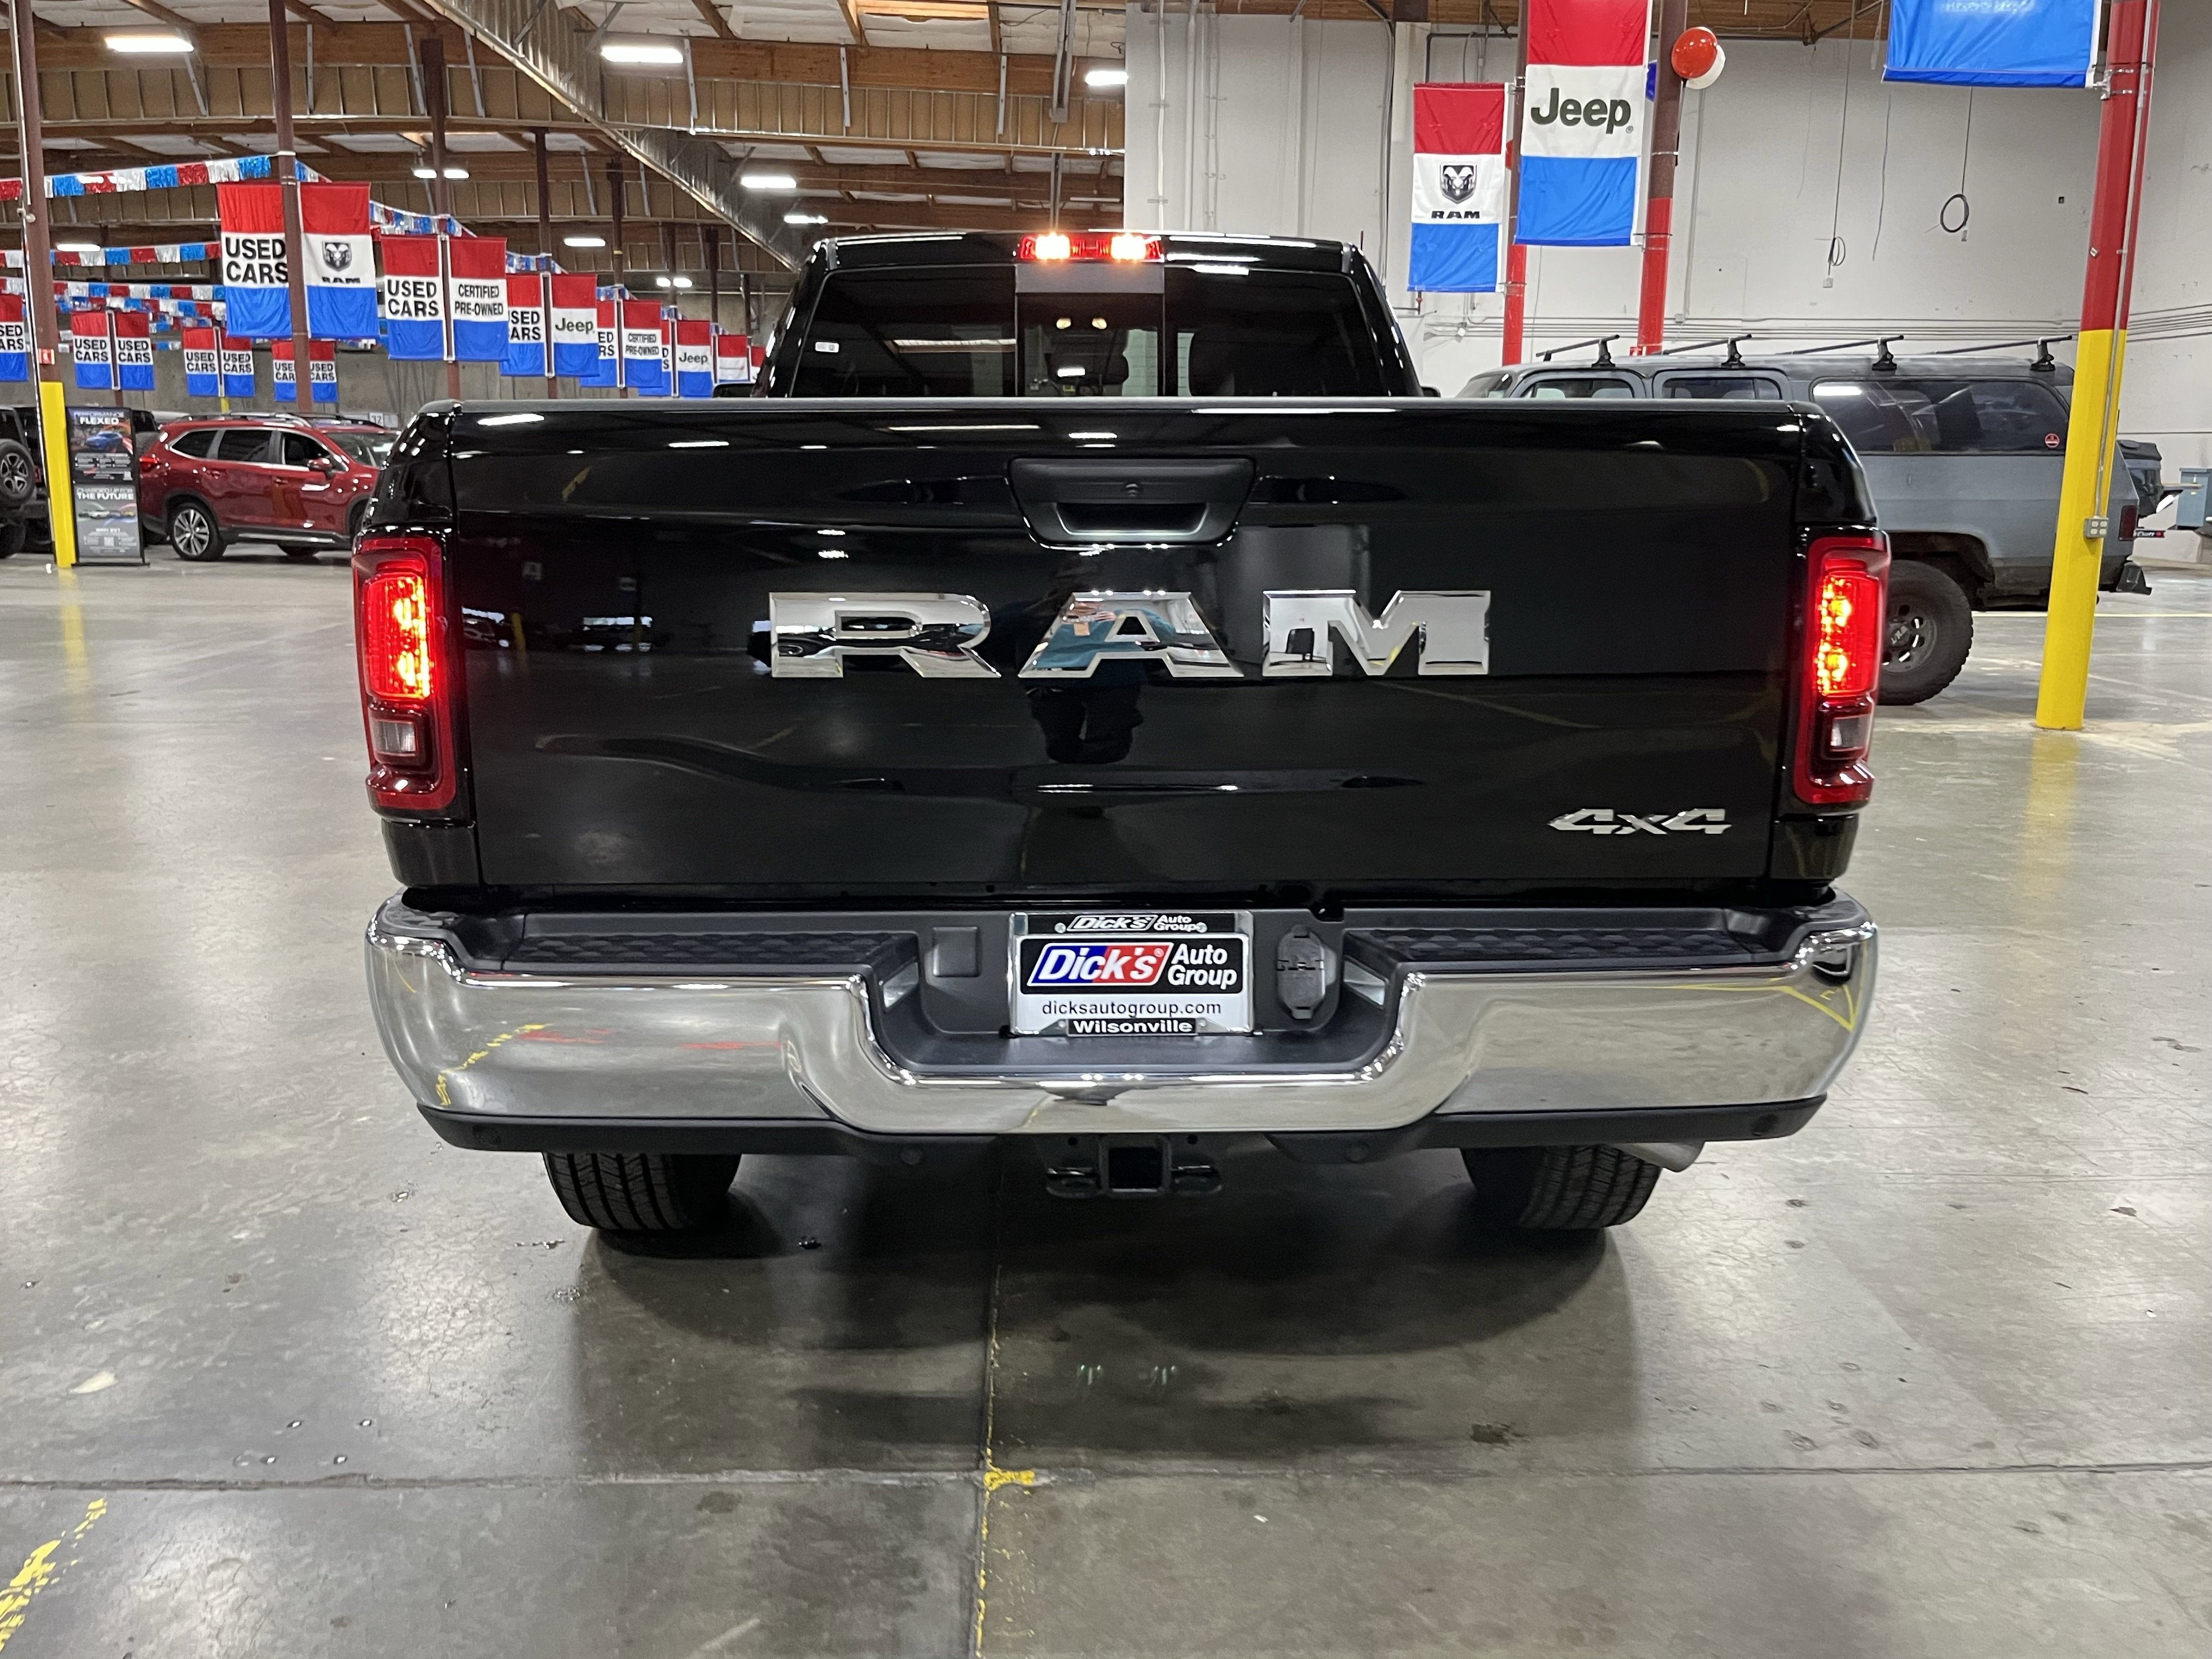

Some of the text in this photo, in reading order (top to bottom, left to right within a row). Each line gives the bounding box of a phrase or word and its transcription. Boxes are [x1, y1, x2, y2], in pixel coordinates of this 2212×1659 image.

[1531, 88, 1631, 134] Jeep
[1431, 210, 1480, 219] RAM
[225, 236, 286, 260] USED
[227, 261, 288, 284] CARS
[387, 279, 437, 298] USED
[458, 284, 499, 298] CERTIFIED
[388, 298, 439, 317] CARS
[455, 301, 504, 316] PRE-OWNED
[509, 311, 540, 325] SED
[0, 325, 22, 336] SED
[555, 318, 594, 334] Jeep
[510, 326, 541, 340] ARS
[598, 331, 613, 343] ED
[628, 333, 656, 343] CERTIFIED
[0, 338, 24, 350] ARS
[75, 339, 107, 350] USED
[118, 340, 149, 351] USED
[76, 351, 109, 362] CARS
[599, 345, 614, 356] RS
[625, 345, 659, 356] PRE-OWNED
[119, 352, 151, 363] CARS
[187, 352, 215, 362] USED
[223, 352, 251, 363] USED
[679, 352, 708, 365] Jeep
[187, 363, 216, 372] CARS
[223, 363, 252, 373] CARS
[275, 363, 293, 371] USE
[276, 372, 295, 381] CAR
[80, 416, 119, 425] FLEXED
[769, 590, 1491, 679] RAM
[1547, 809, 1732, 834] 4x4
[1073, 916, 1149, 929] Dick's
[1156, 915, 1192, 923] Auto
[1154, 922, 1197, 932] Group
[1171, 944, 1228, 964] Auto
[1038, 947, 1157, 981] Dick's
[1167, 964, 1238, 990] Group
[1042, 1001, 1221, 1018] dicksautogroup.com
[1074, 1020, 1193, 1034] Wilsonville
